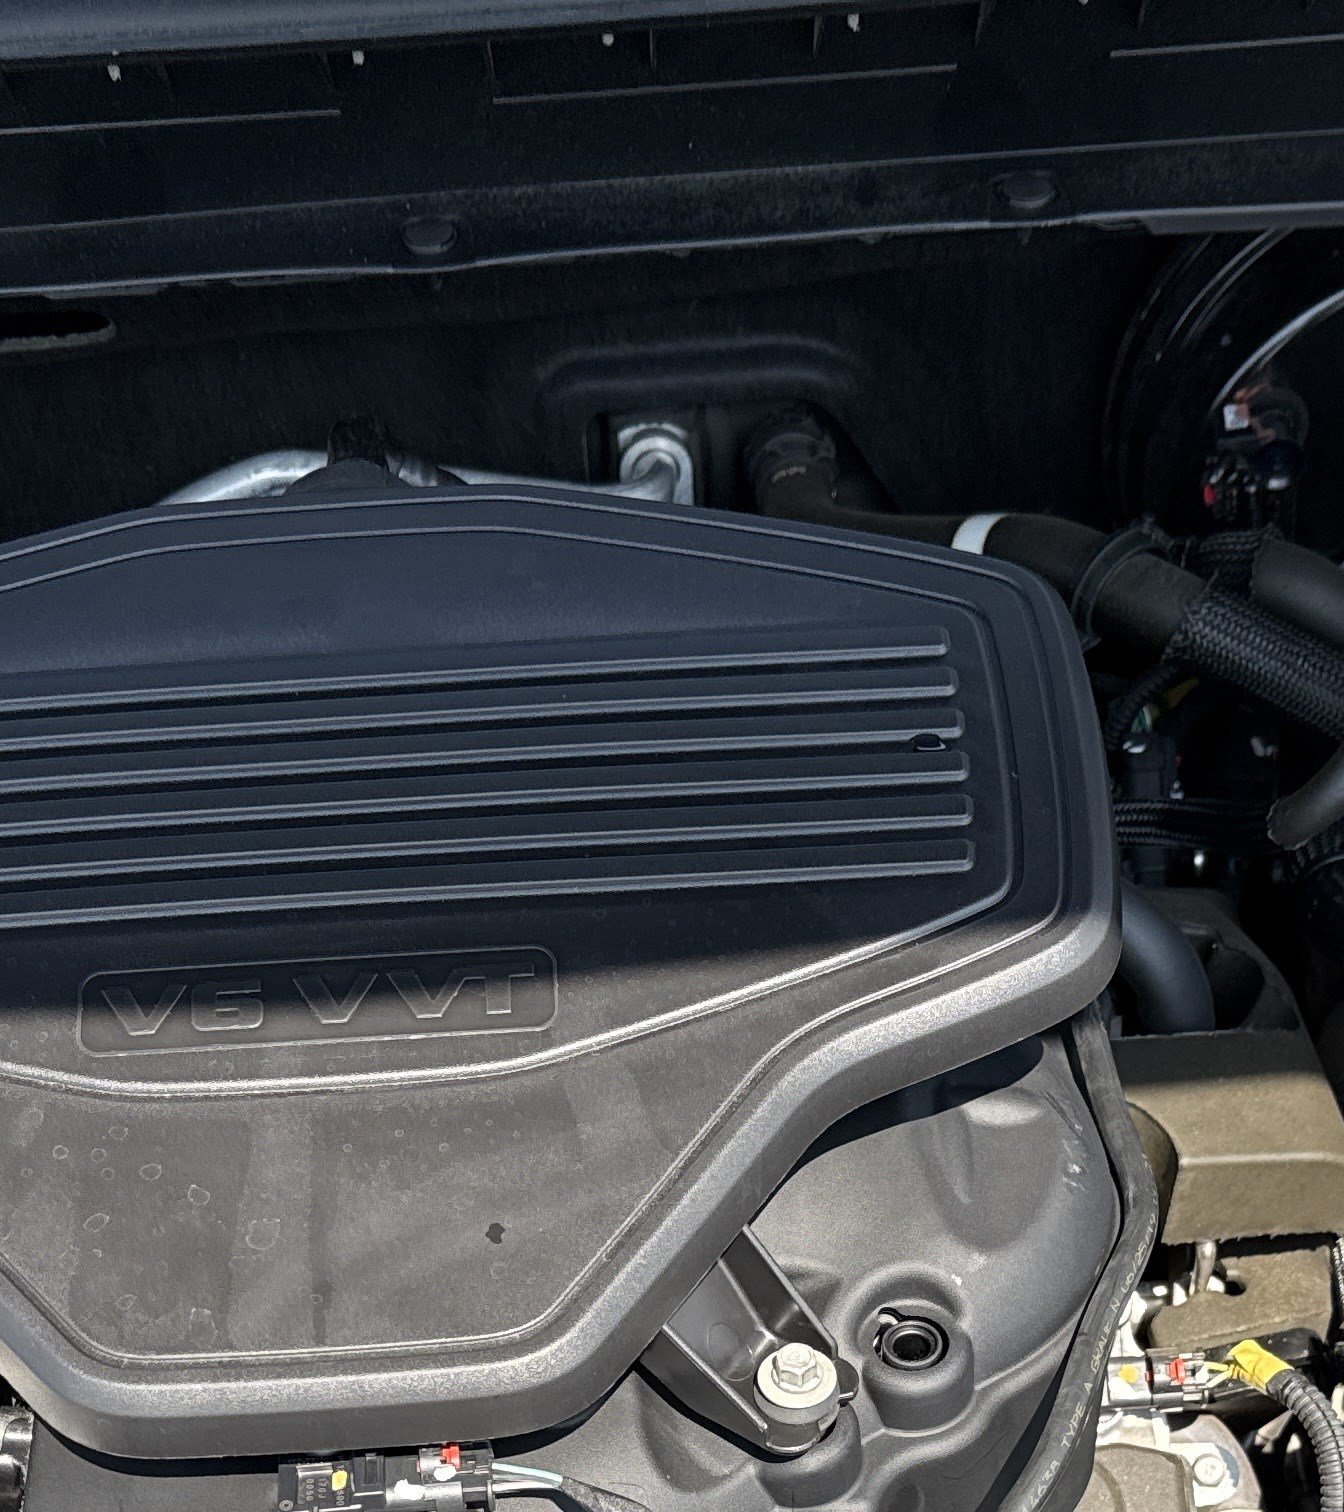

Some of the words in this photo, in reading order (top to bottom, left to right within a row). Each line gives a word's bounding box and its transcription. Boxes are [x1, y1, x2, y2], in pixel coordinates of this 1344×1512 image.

[101, 981, 264, 1037] V6
[293, 963, 535, 1025] VVT
[1060, 1402, 1086, 1448] TYPE
[1084, 1382, 1094, 1400] A
